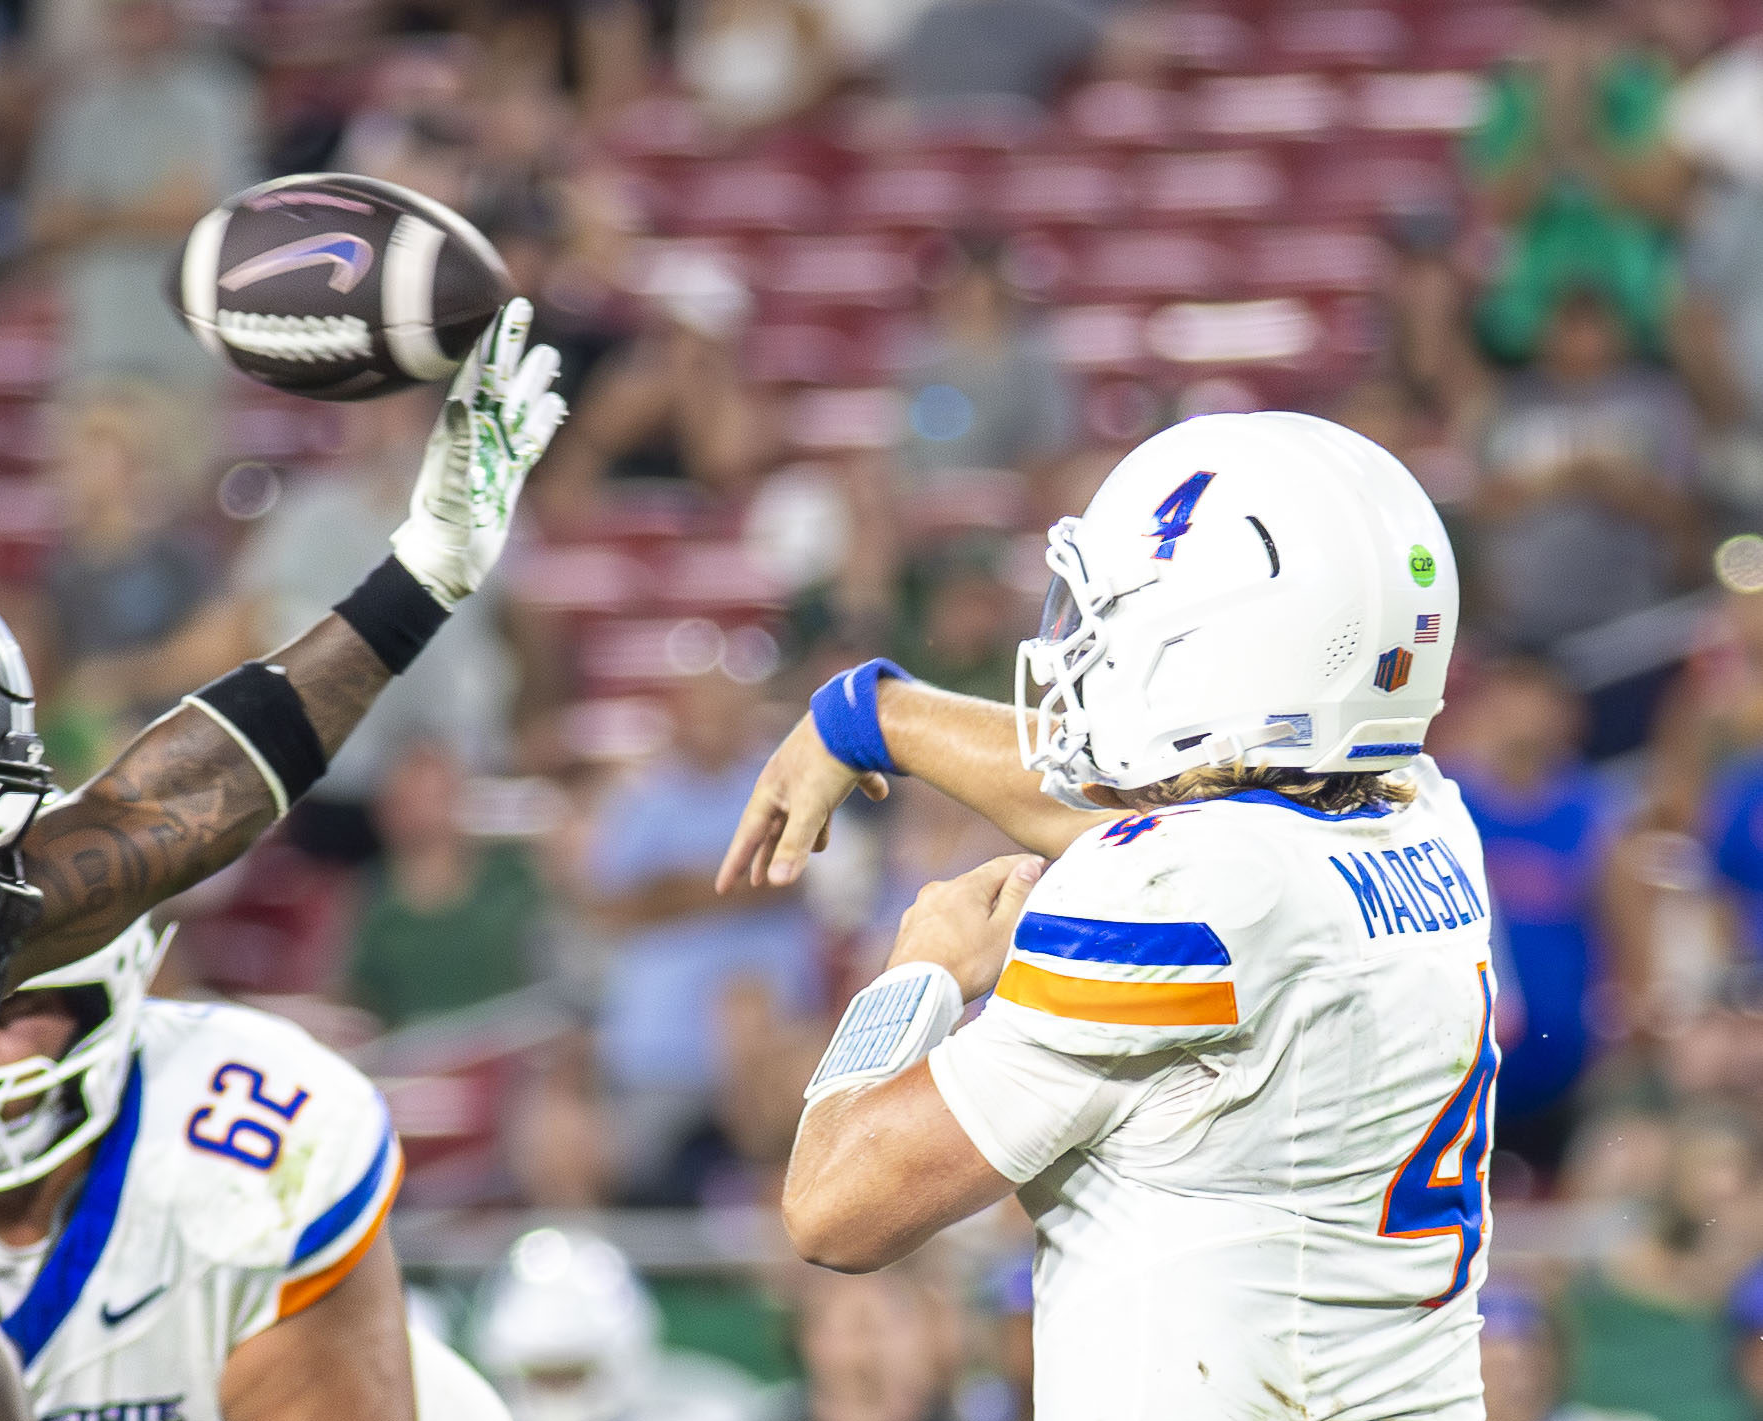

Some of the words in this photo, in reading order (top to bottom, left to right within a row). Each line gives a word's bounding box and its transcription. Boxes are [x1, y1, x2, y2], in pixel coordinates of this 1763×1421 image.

[1142, 470, 1217, 561] 4
[1411, 557, 1434, 572] C2P
[1099, 809, 1199, 848] 4
[1329, 837, 1486, 940] MADSEN
[185, 1060, 312, 1175] 62
[1377, 961, 1500, 1309] 4
